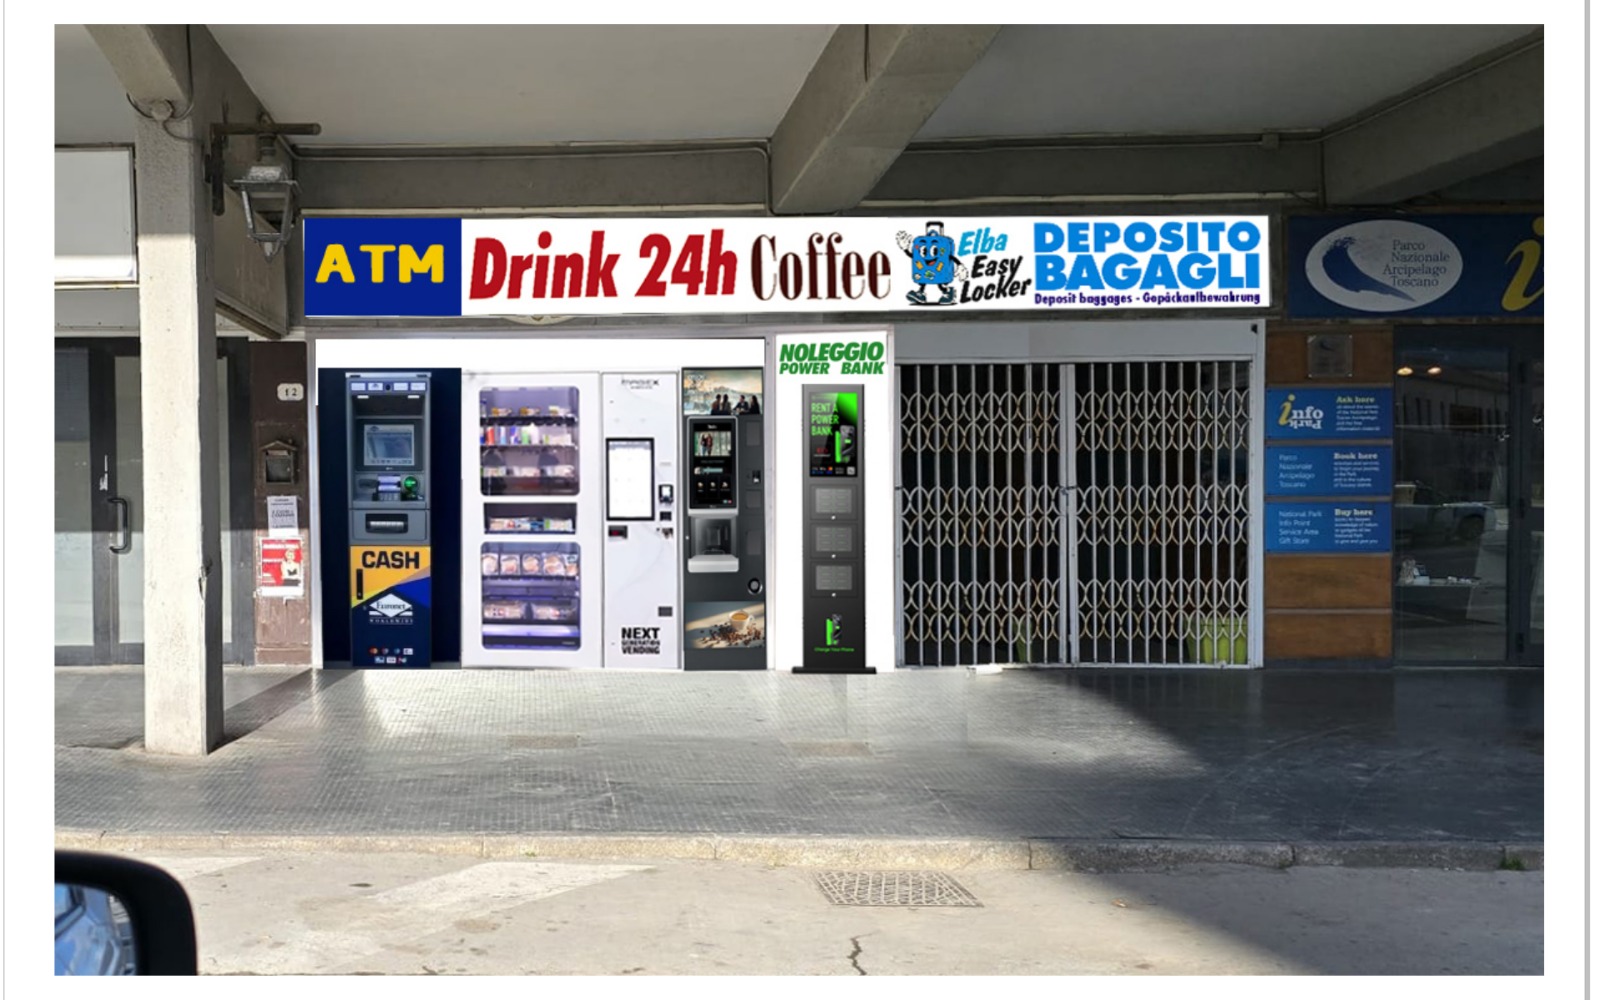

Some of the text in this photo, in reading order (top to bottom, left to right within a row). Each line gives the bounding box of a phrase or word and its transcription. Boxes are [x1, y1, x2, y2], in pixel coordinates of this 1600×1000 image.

[957, 227, 1008, 256] Elba
[1034, 221, 1261, 253] DEPOSITO
[1393, 239, 1425, 251] Parco
[315, 244, 444, 283] ATM
[469, 228, 738, 299] Drink 24h
[1391, 251, 1451, 263] Nazionale
[751, 231, 892, 301] Coffee
[971, 255, 1023, 280] Easy
[1035, 253, 1260, 291] BAGAGLI
[1382, 263, 1447, 278] Arcipelago
[1389, 275, 1439, 287] Toscano
[960, 275, 1033, 303] Locker
[1034, 293, 1076, 306] Deposit
[1079, 293, 1132, 306] baggages
[779, 341, 884, 362] NOLEGGIO
[779, 362, 885, 375] POWER BANK
[811, 403, 839, 413] RENT A
[1278, 394, 1324, 426] info
[811, 415, 839, 425] POWER
[811, 426, 833, 436] BANK
[1333, 452, 1378, 460] Book here
[1334, 508, 1373, 517] Buy here
[361, 551, 420, 569] CASH
[621, 627, 660, 639] NEXT
[622, 646, 660, 655] VENDING
